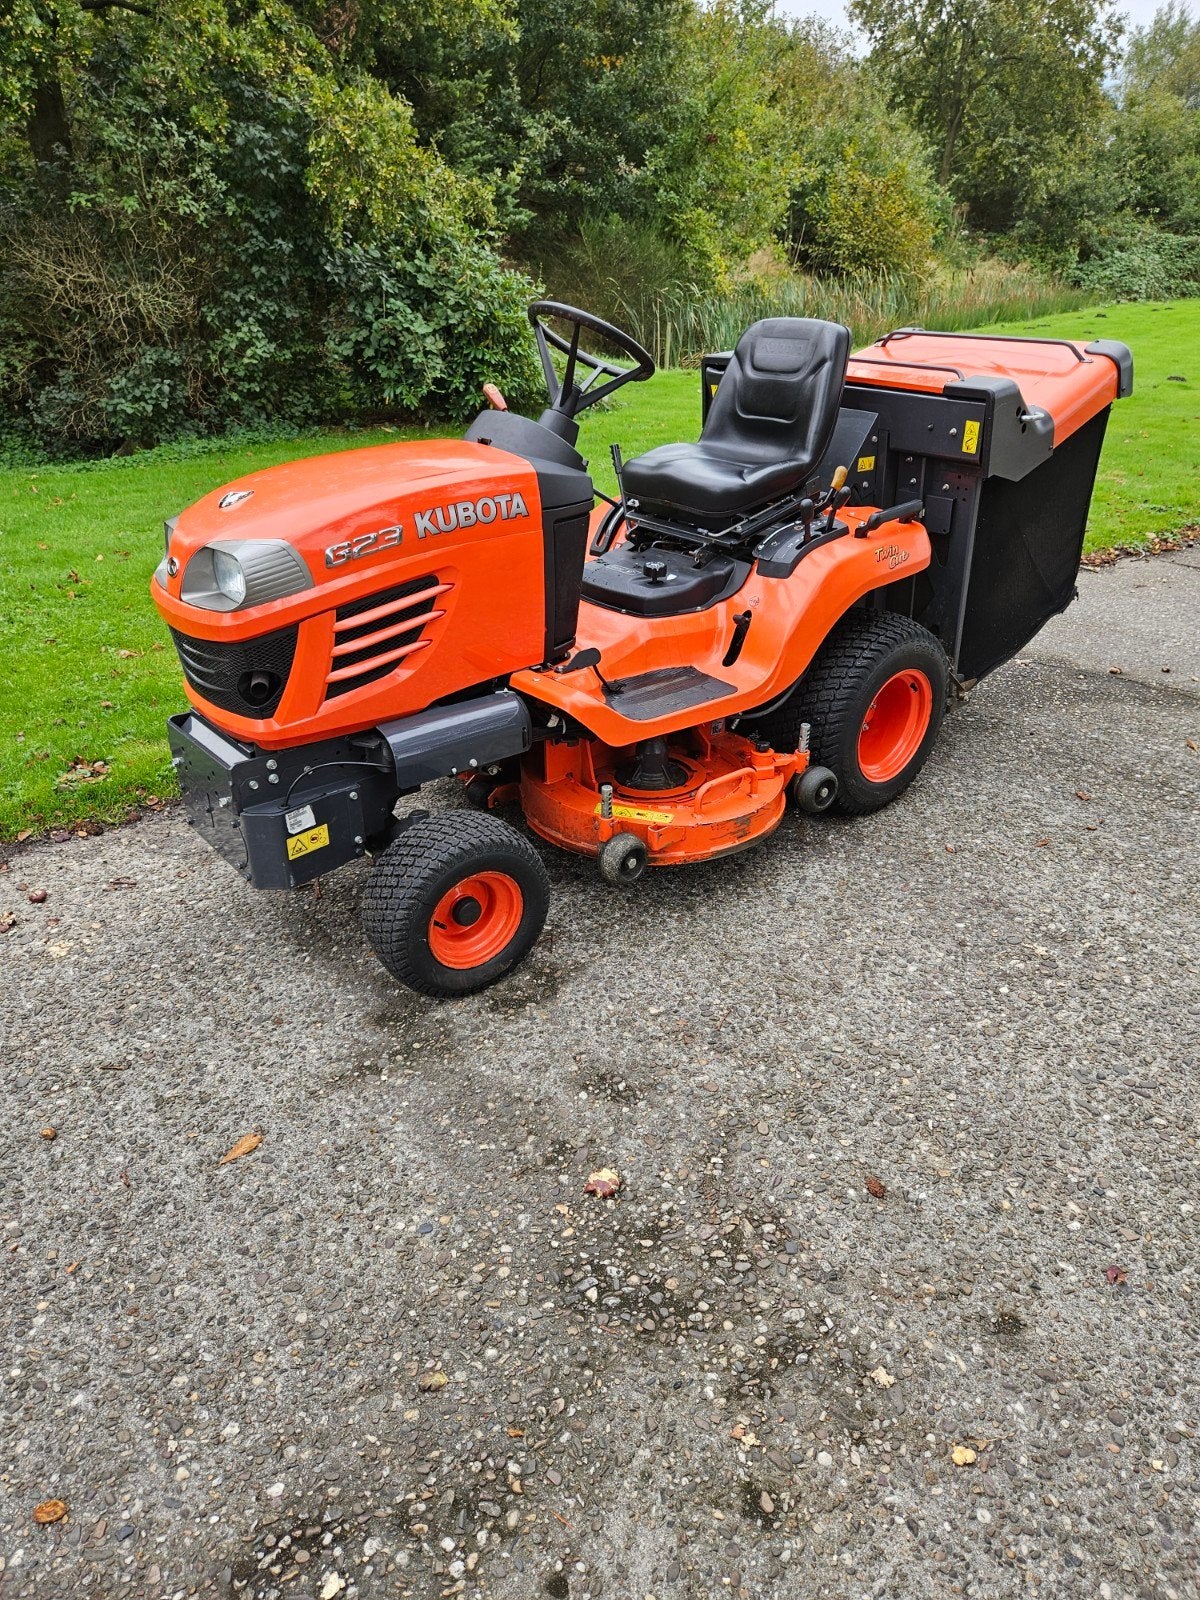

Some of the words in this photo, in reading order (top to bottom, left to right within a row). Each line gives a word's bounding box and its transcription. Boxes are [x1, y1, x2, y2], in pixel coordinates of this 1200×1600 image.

[325, 524, 404, 569] G23
[414, 492, 529, 539] KUBOTA
[875, 545, 899, 562] Twin
[889, 550, 910, 569] Cut
